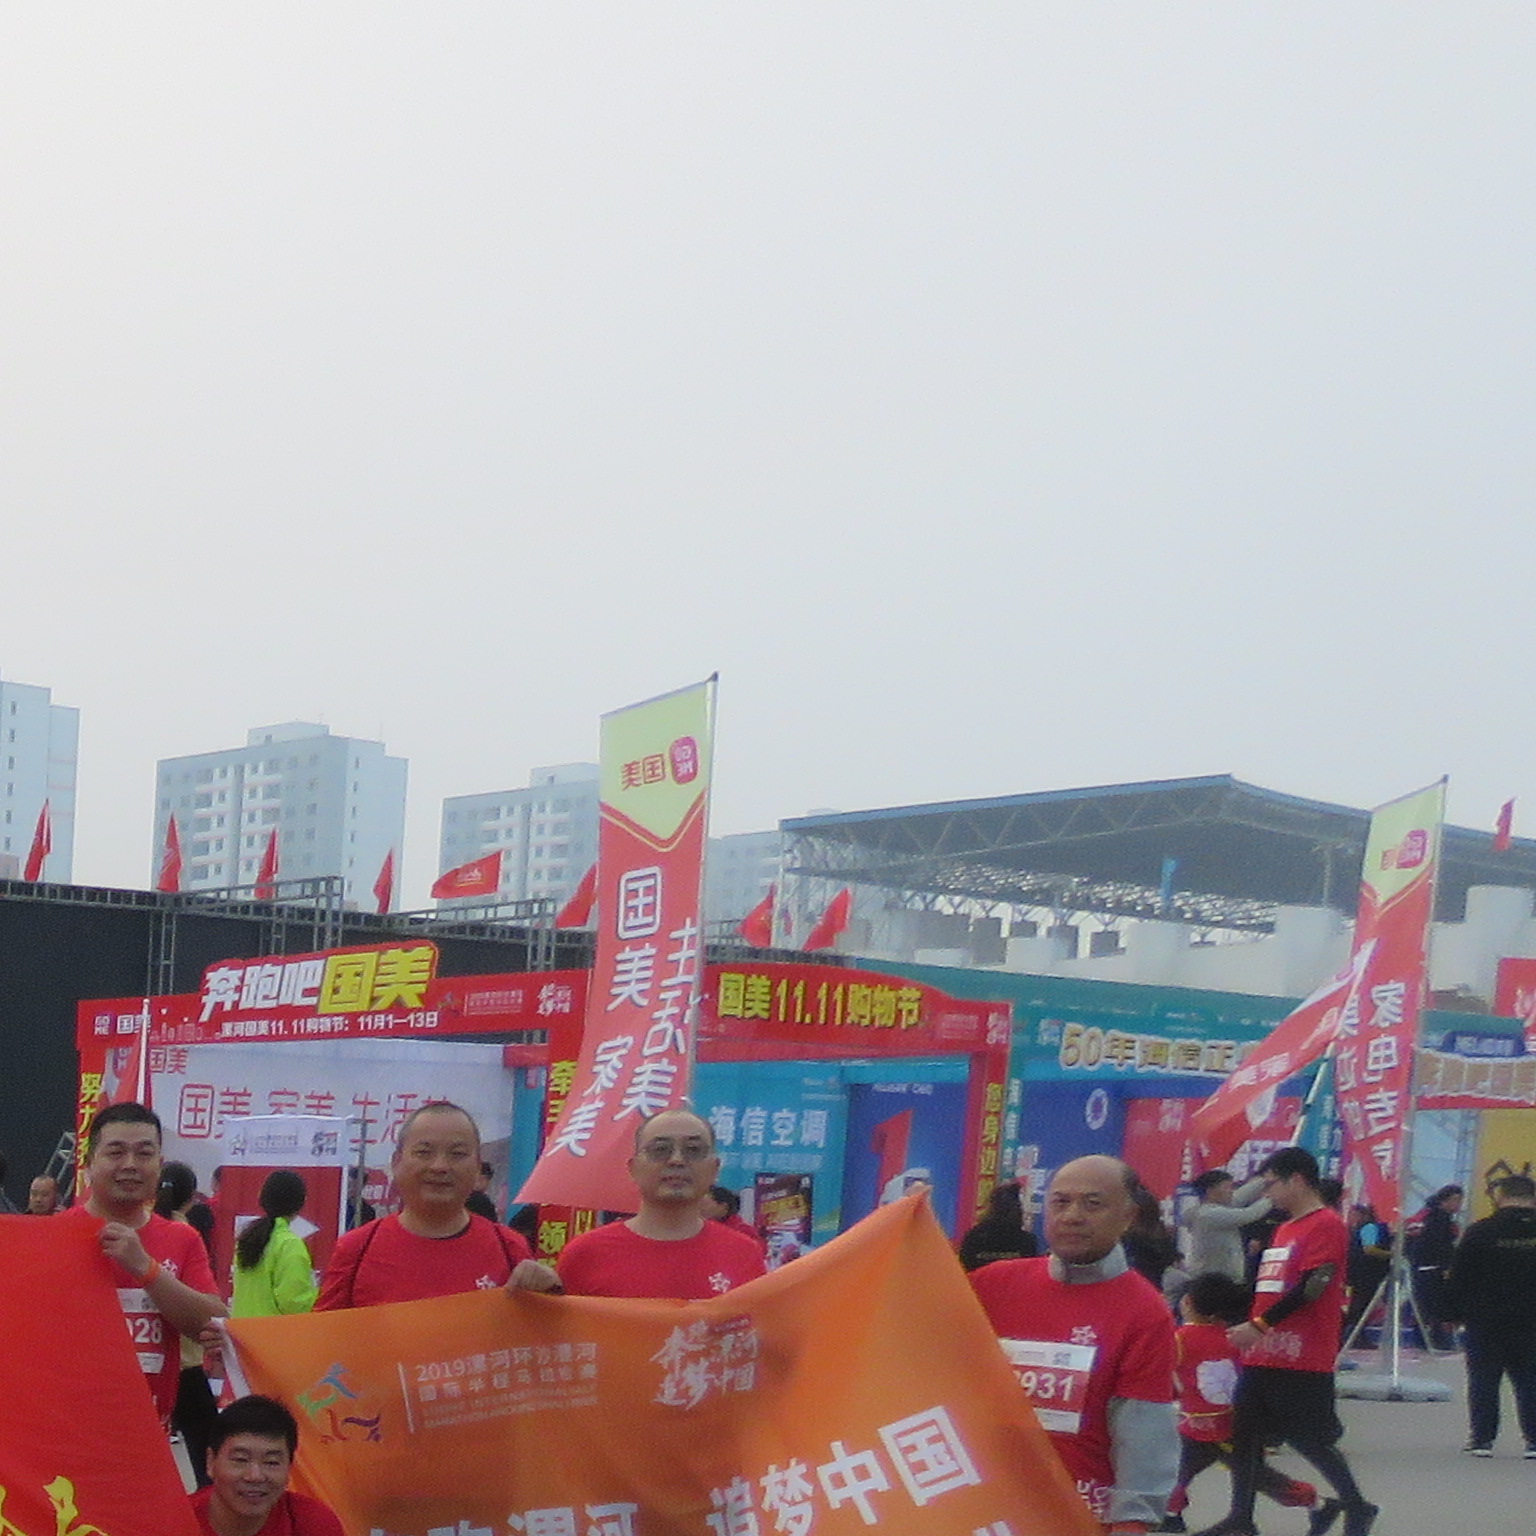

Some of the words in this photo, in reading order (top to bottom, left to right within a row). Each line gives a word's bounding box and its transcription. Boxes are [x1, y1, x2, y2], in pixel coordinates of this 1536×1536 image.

[198, 945, 435, 1022] 奔跑吧国美
[716, 971, 923, 1030] 国美11.11购物节
[708, 1105, 829, 1149] 海信空调
[415, 1342, 598, 1383] 2019漯河环沙澧河
[1013, 1370, 1075, 1402] 931
